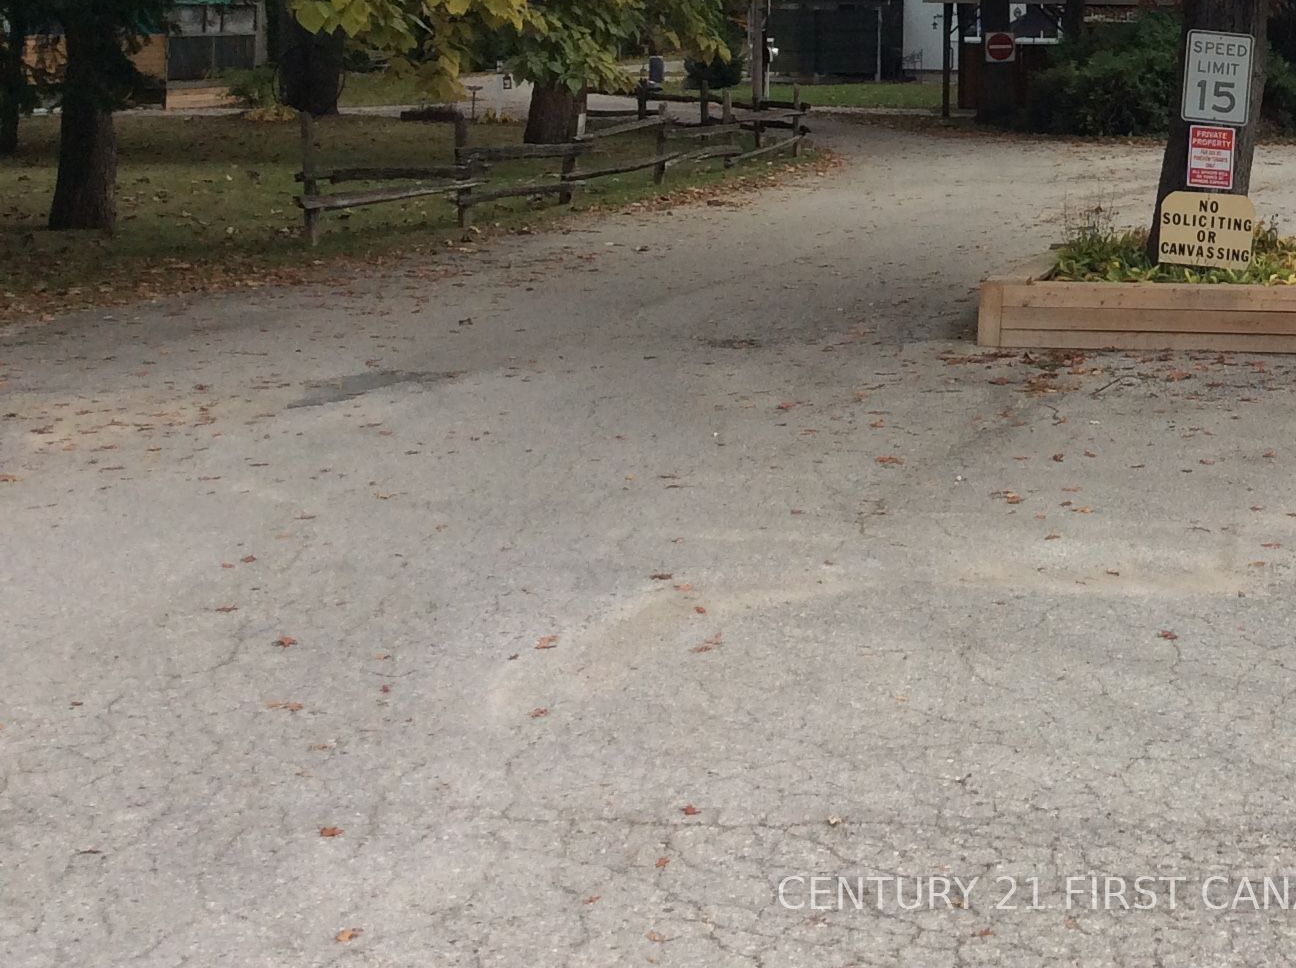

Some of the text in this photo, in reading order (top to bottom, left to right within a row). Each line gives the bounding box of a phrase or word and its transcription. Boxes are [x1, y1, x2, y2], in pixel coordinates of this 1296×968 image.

[1193, 41, 1247, 57] SPEED
[1198, 60, 1240, 76] LIMIT
[1197, 80, 1236, 113] 15
[1192, 138, 1231, 148] PROPERTY
[1197, 130, 1228, 140] PRIVATE
[1199, 200, 1219, 213] NO
[1163, 213, 1252, 232] SOLICITING
[1197, 230, 1216, 244] OR
[1161, 242, 1249, 262] CANVASSING
